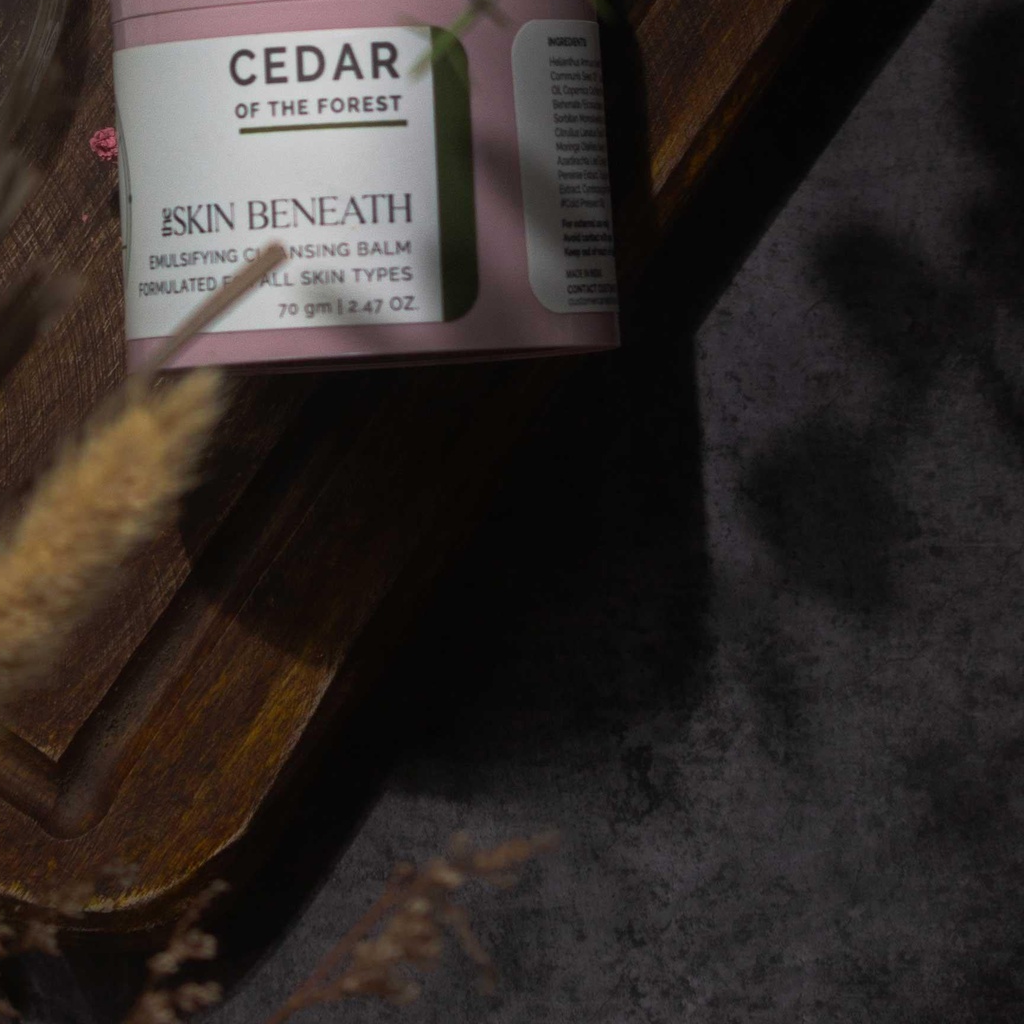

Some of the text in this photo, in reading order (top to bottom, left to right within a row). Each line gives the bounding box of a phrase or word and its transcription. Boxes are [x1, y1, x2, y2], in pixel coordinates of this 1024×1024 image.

[230, 42, 400, 86] CEDAR
[235, 95, 402, 119] OF THE FOREST
[161, 207, 173, 237] the
[173, 193, 413, 236] SKIN BENEATH
[149, 240, 412, 270] EMULSIFYING CLNSING BALM
[139, 276, 217, 297] FORMULATED
[260, 270, 294, 287] ALL
[300, 269, 345, 286] SKIN
[351, 266, 414, 283] TYPES
[277, 303, 299, 318] 70
[304, 302, 332, 319] gm
